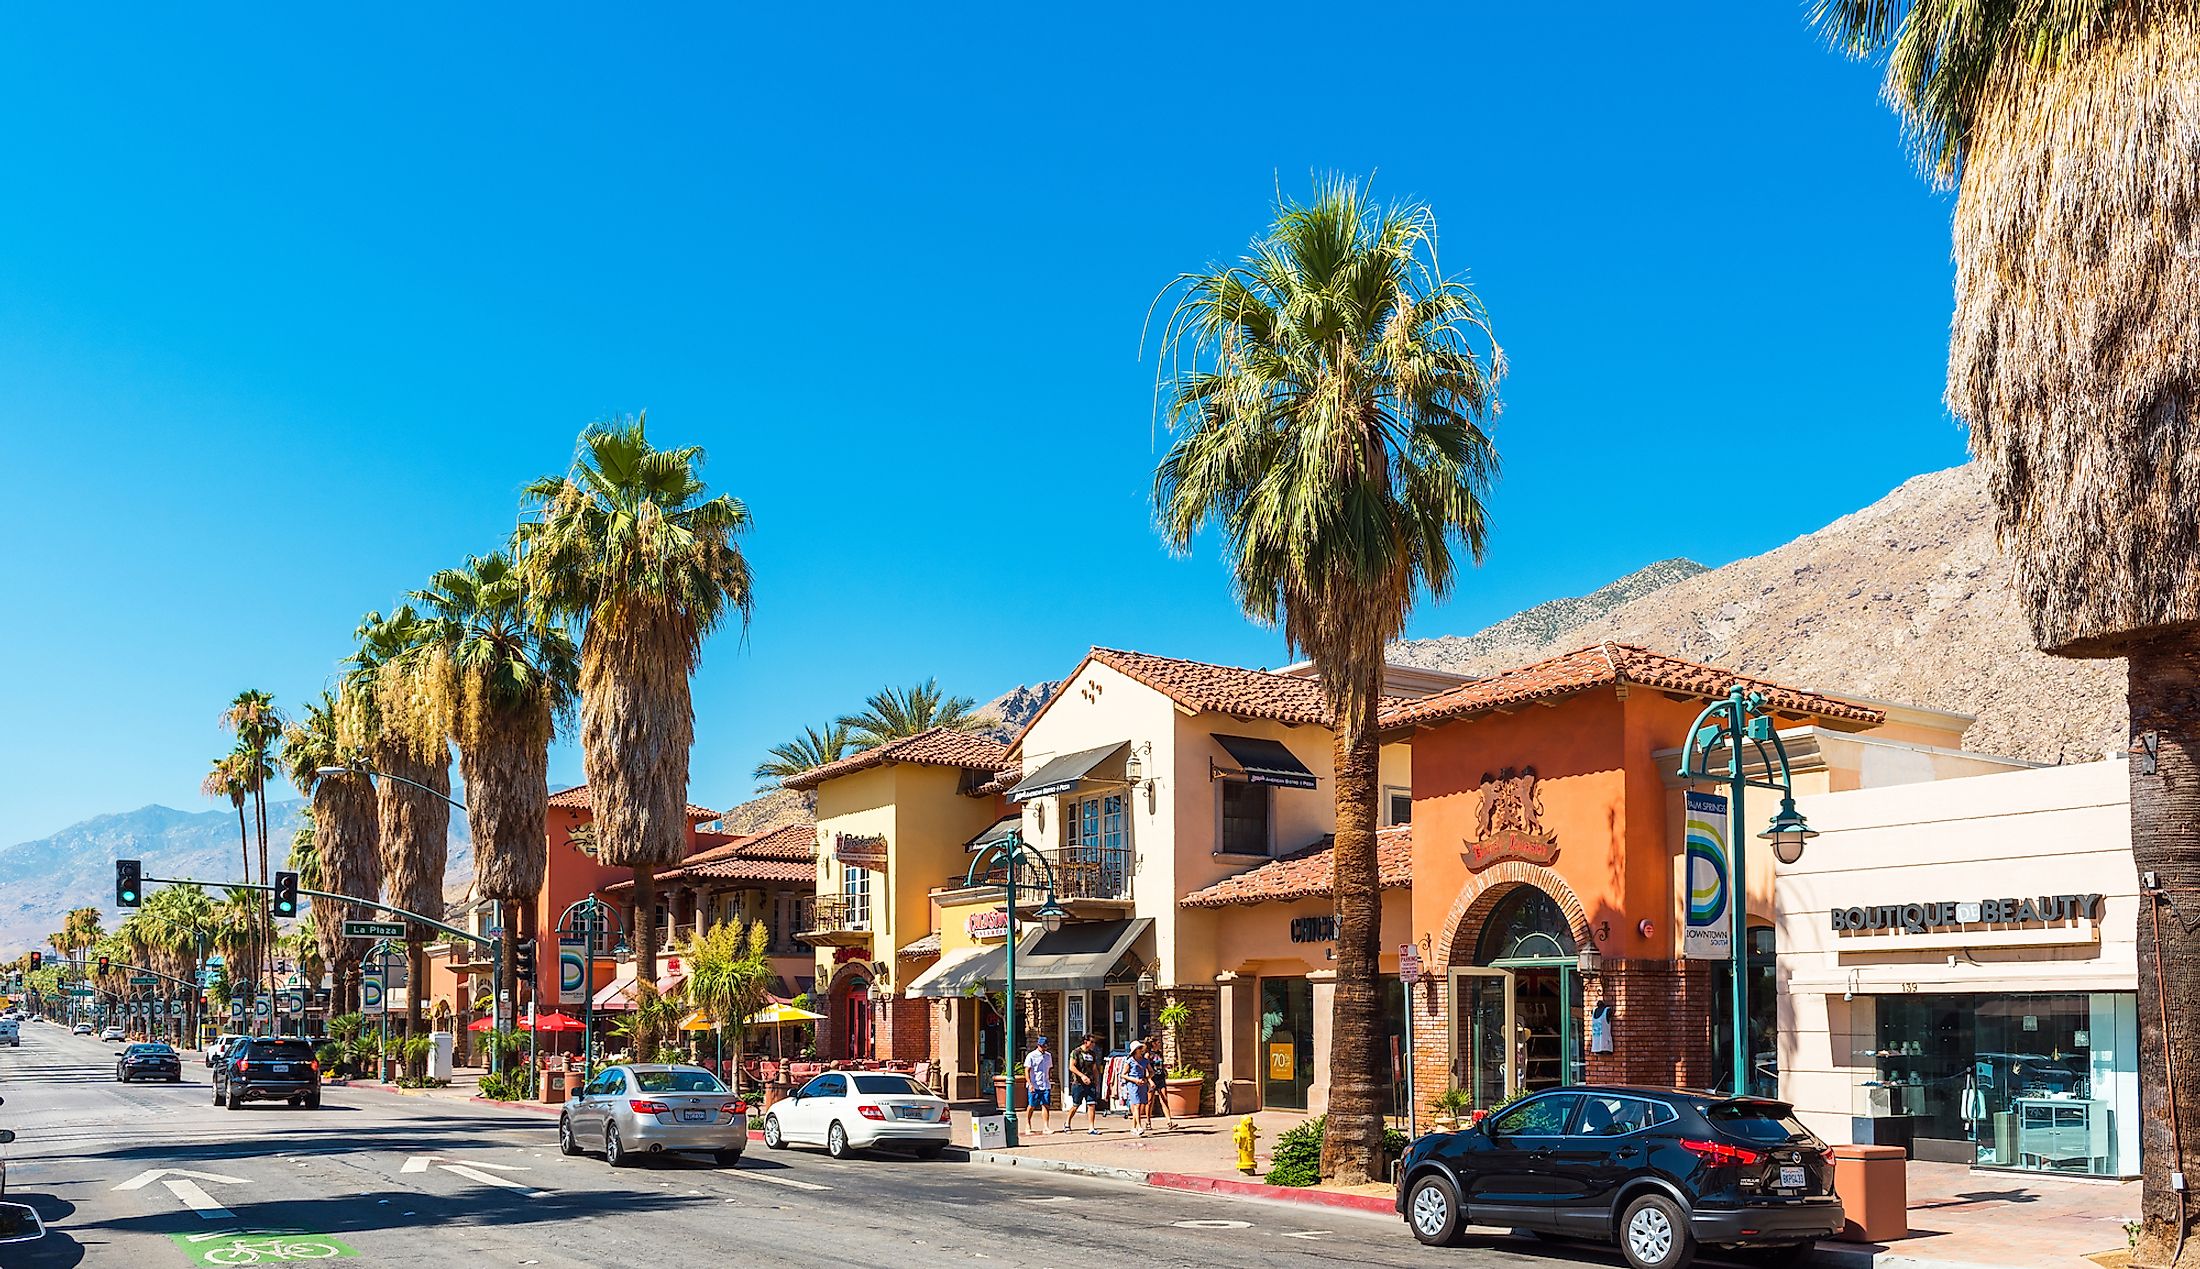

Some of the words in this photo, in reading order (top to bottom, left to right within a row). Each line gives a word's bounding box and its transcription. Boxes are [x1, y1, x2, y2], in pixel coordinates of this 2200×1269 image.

[1702, 802, 1727, 814] SPRINGS
[1831, 901, 1957, 935] BOUTIQUE
[1958, 903, 1979, 923] DE
[1982, 894, 2103, 924] BEAUTY
[353, 925, 366, 934] La
[369, 925, 397, 935] Plaza
[1686, 929, 1728, 939] DOWNTOWN
[1901, 983, 1918, 993] 139
